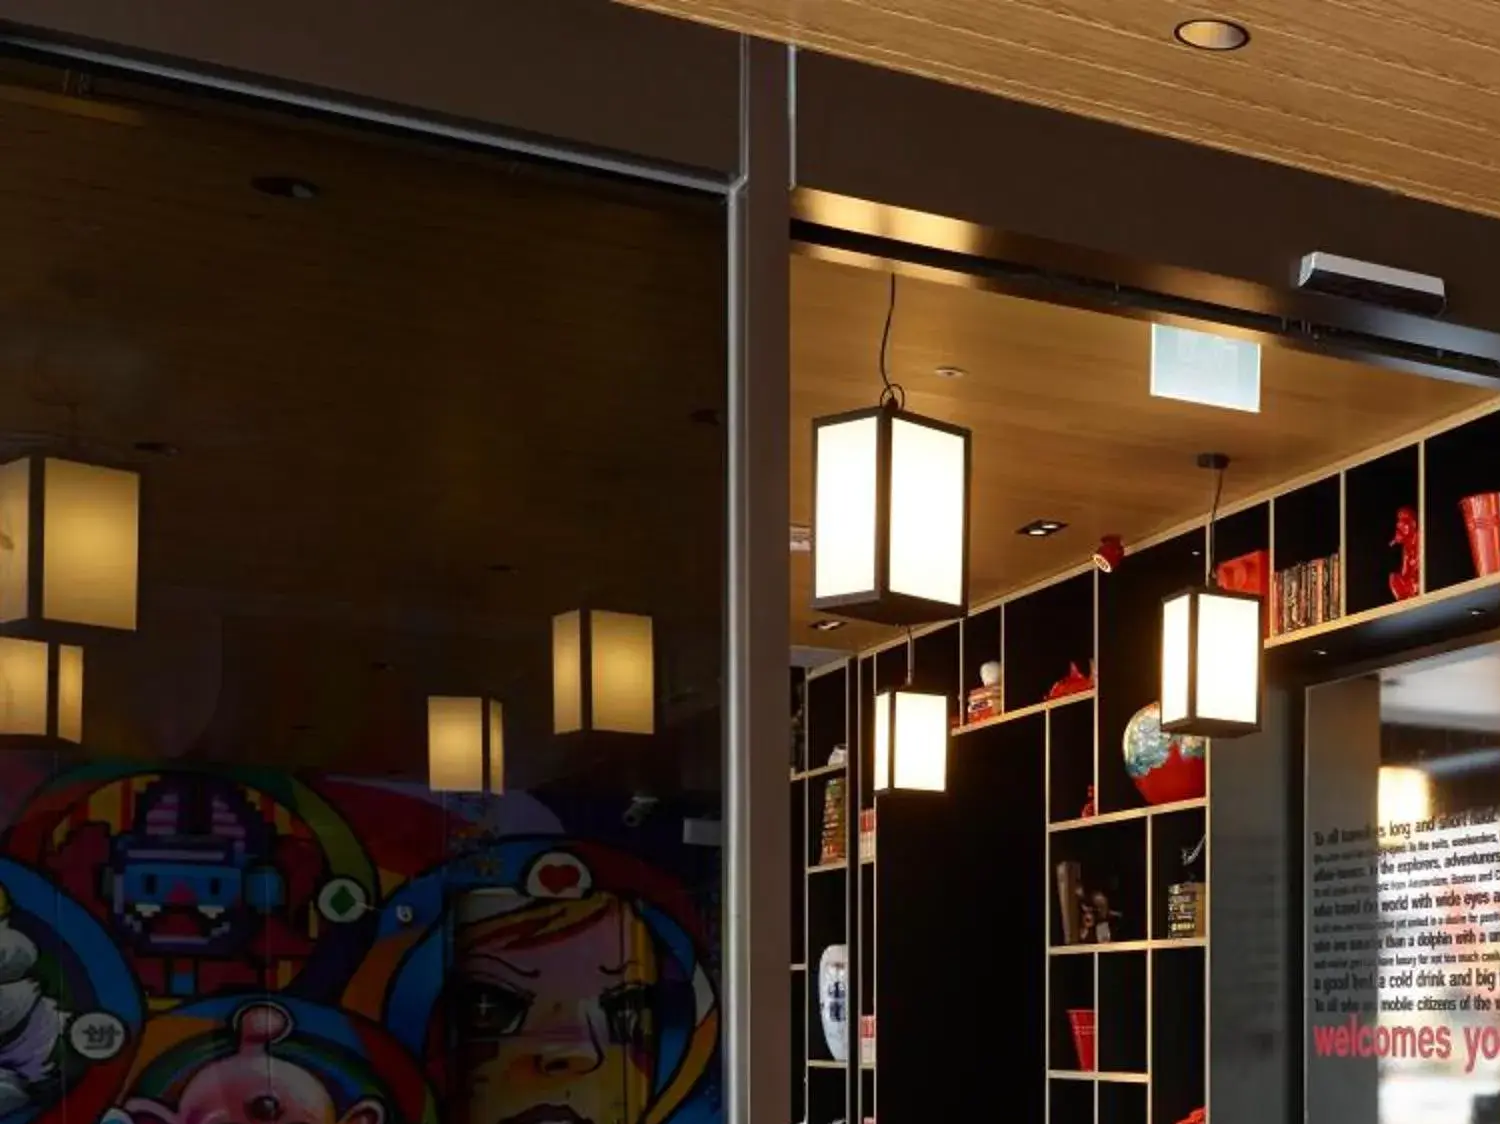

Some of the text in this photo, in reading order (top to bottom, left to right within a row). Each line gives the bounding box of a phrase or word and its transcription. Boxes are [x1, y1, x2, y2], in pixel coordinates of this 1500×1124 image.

[1389, 820, 1411, 840] long
[1415, 815, 1436, 833] and
[1380, 858, 1395, 875] the
[1381, 894, 1409, 912] world
[1411, 892, 1433, 909] with
[1436, 889, 1462, 907] wide
[1463, 890, 1490, 910] eyes
[1385, 934, 1406, 949] than
[1417, 931, 1453, 950] dolphin
[1456, 928, 1476, 945] with
[1389, 970, 1413, 989] cold
[1416, 968, 1447, 988] drink
[1449, 967, 1473, 987] and
[1475, 967, 1497, 993] big
[1381, 995, 1415, 1012] mobile
[1417, 995, 1457, 1012] citizens
[1459, 994, 1471, 1011] of
[1473, 993, 1493, 1011] the
[1312, 1012, 1453, 1058] welcomes
